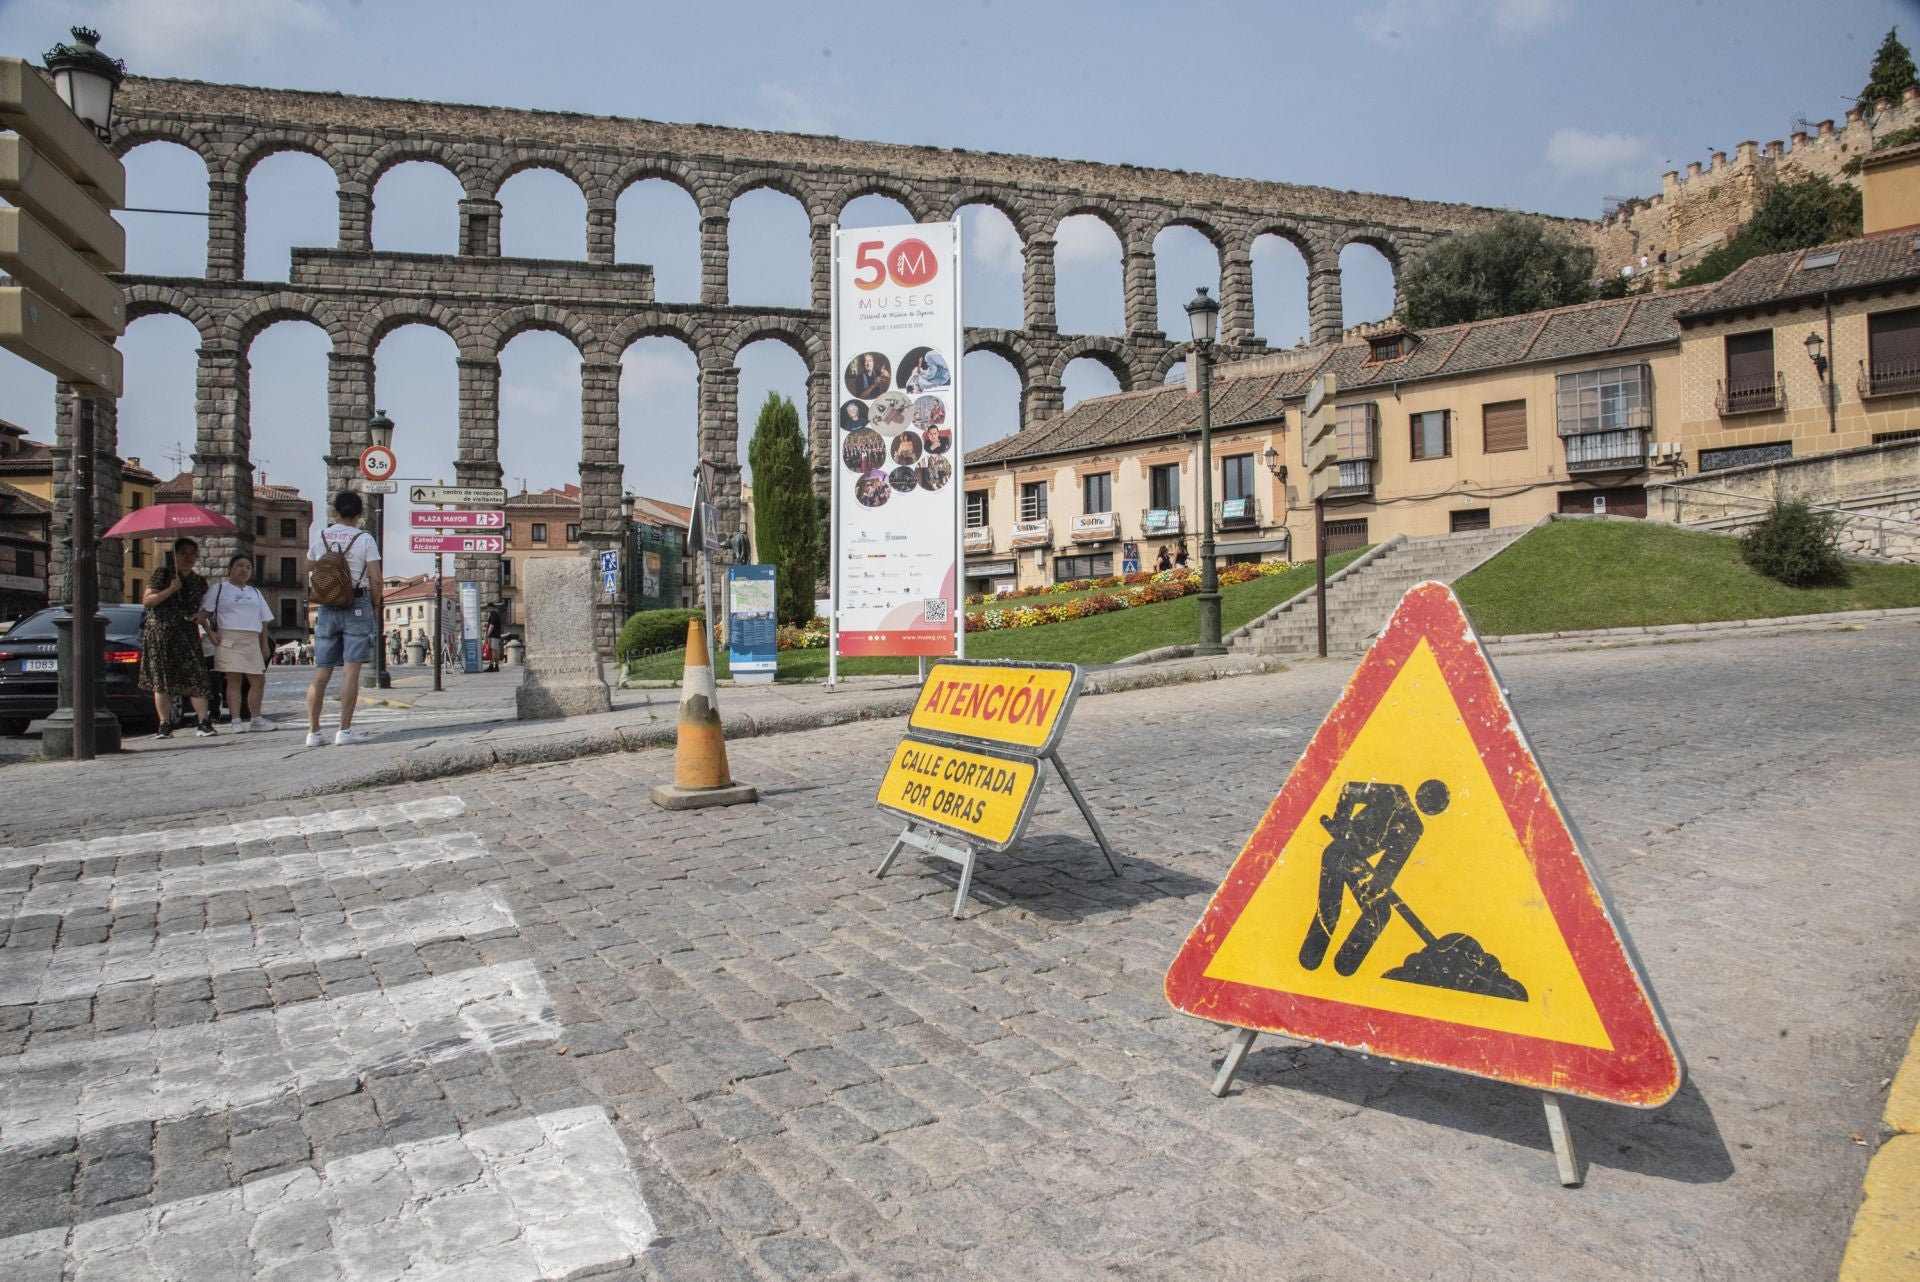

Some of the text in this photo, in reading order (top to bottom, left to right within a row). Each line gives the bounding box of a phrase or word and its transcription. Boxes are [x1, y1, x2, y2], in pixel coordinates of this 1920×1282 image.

[859, 294, 934, 310] MUSEG
[442, 488, 503, 498] centro de recepción
[30, 661, 54, 669] 1083
[924, 675, 1056, 726] ATENCIÓN
[901, 749, 1017, 796] CALLE CORTADA
[901, 781, 987, 824] POR OBRAS
